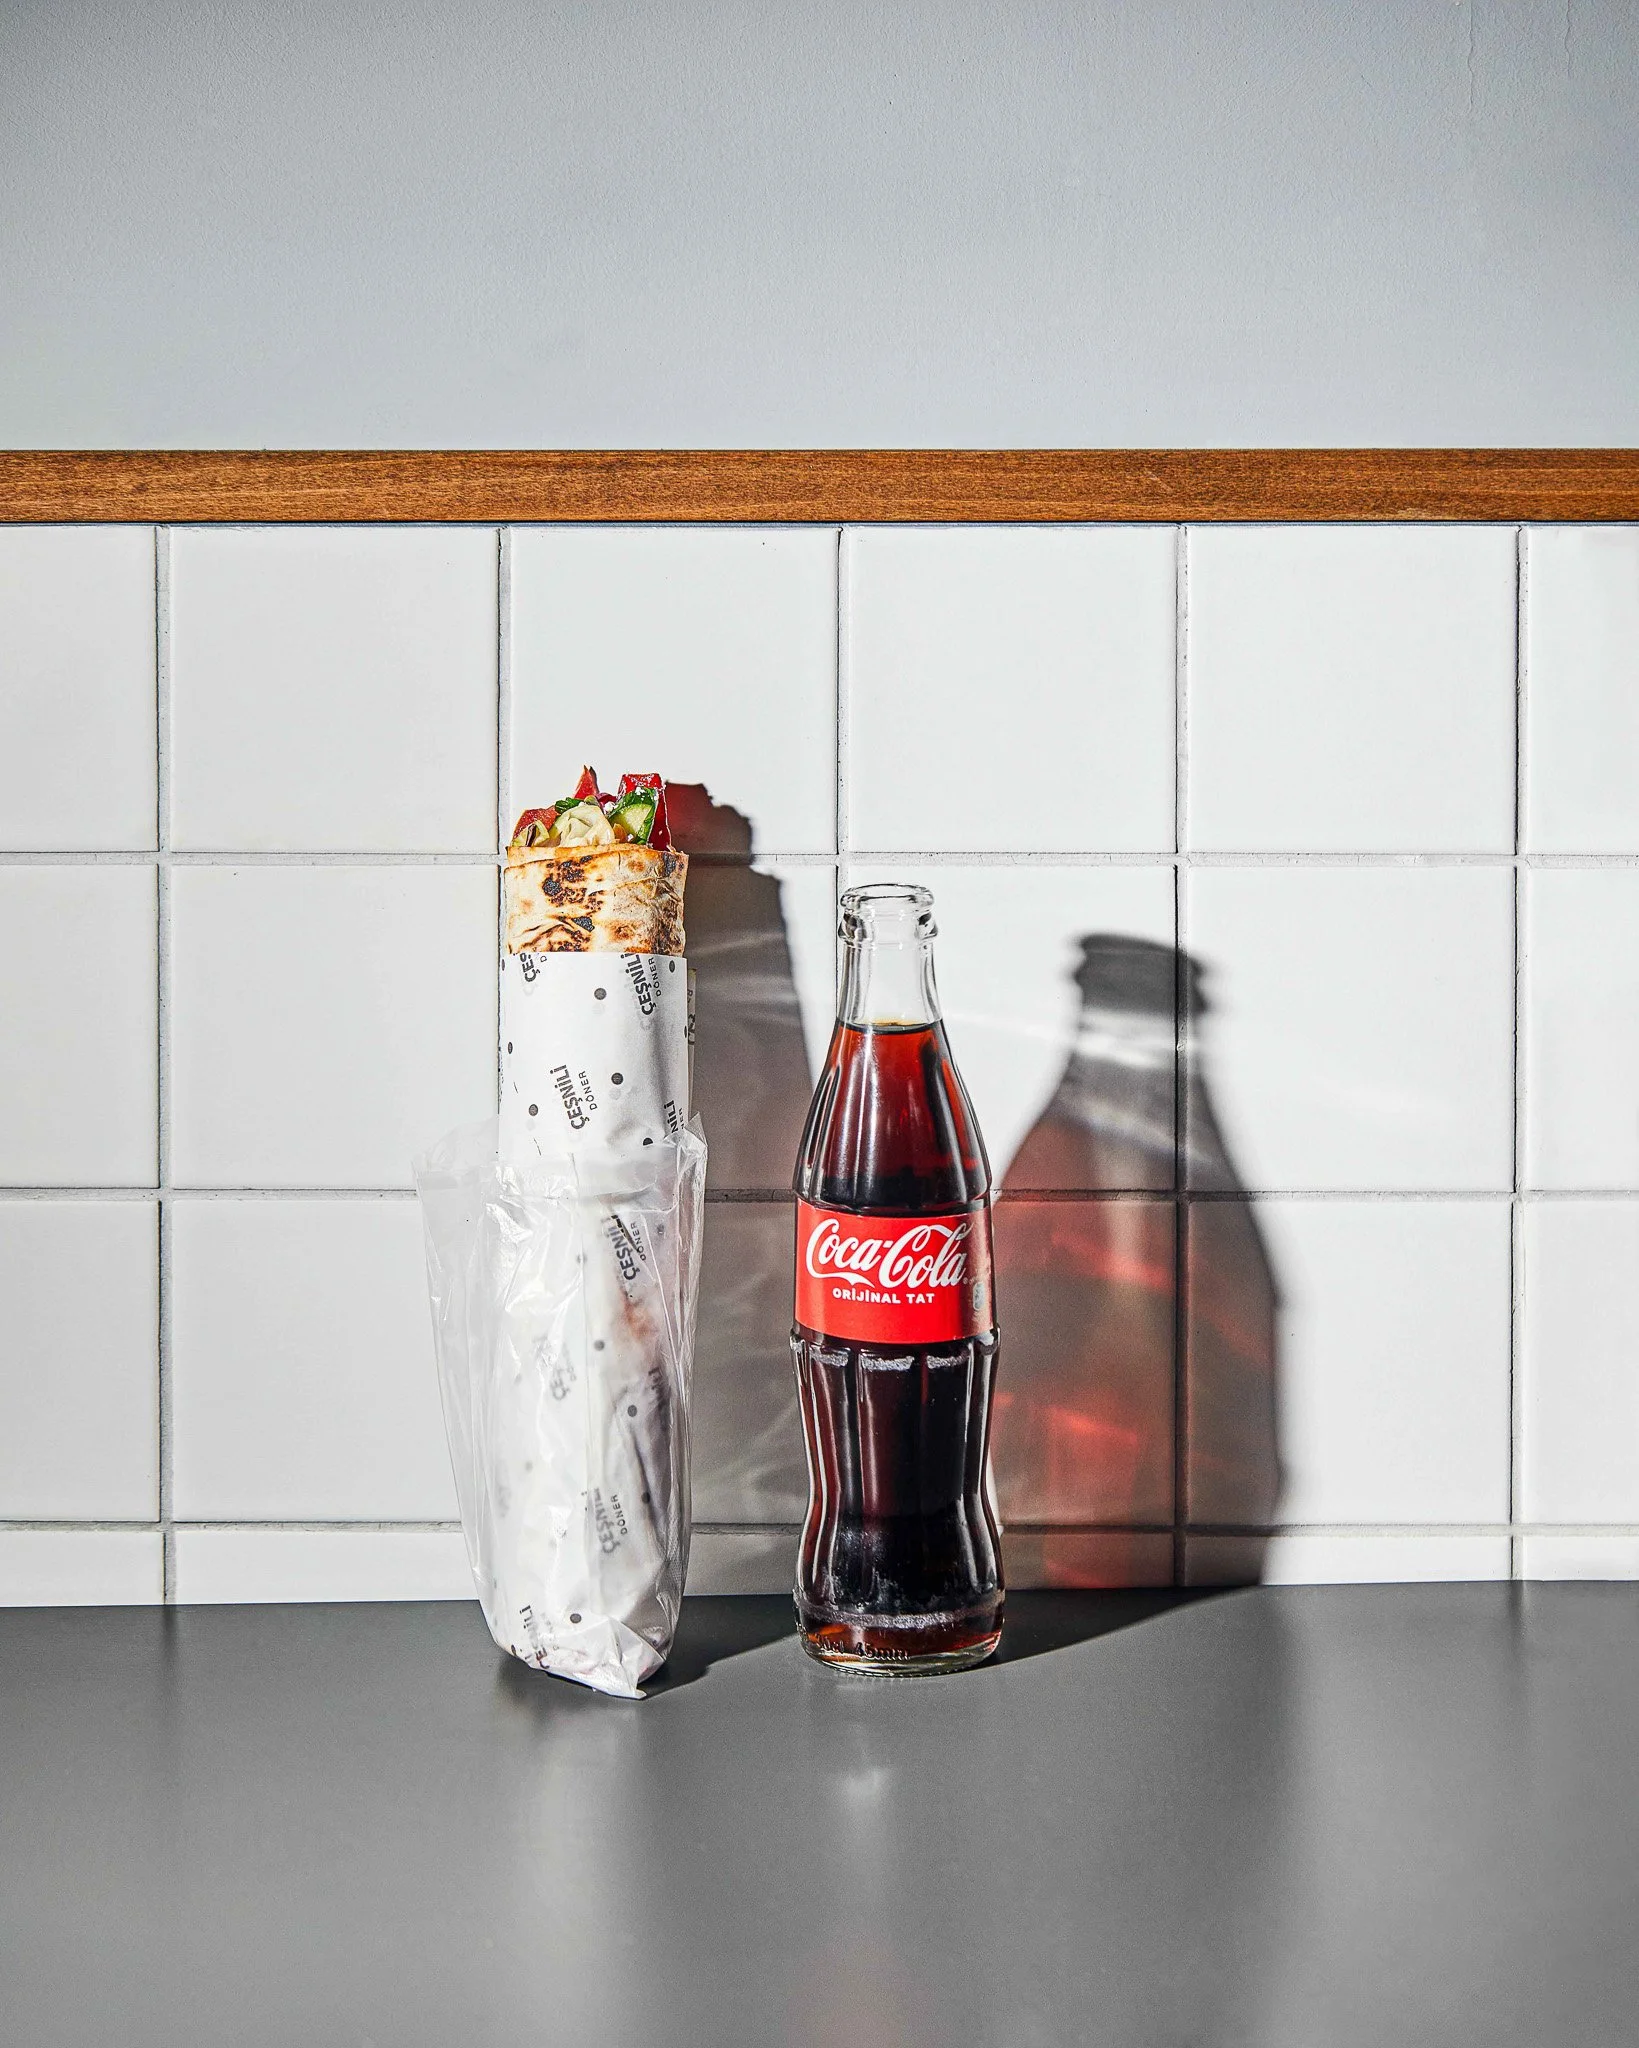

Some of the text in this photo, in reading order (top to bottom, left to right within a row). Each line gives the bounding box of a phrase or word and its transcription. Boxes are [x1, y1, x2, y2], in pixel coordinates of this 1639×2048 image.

[550, 1064, 590, 1130] ÇEŞNİLİ
[578, 1070, 598, 1111] DÖNER
[806, 1218, 974, 1289] Coca-Cola
[832, 1287, 936, 1304] ORİJİNAL TAT
